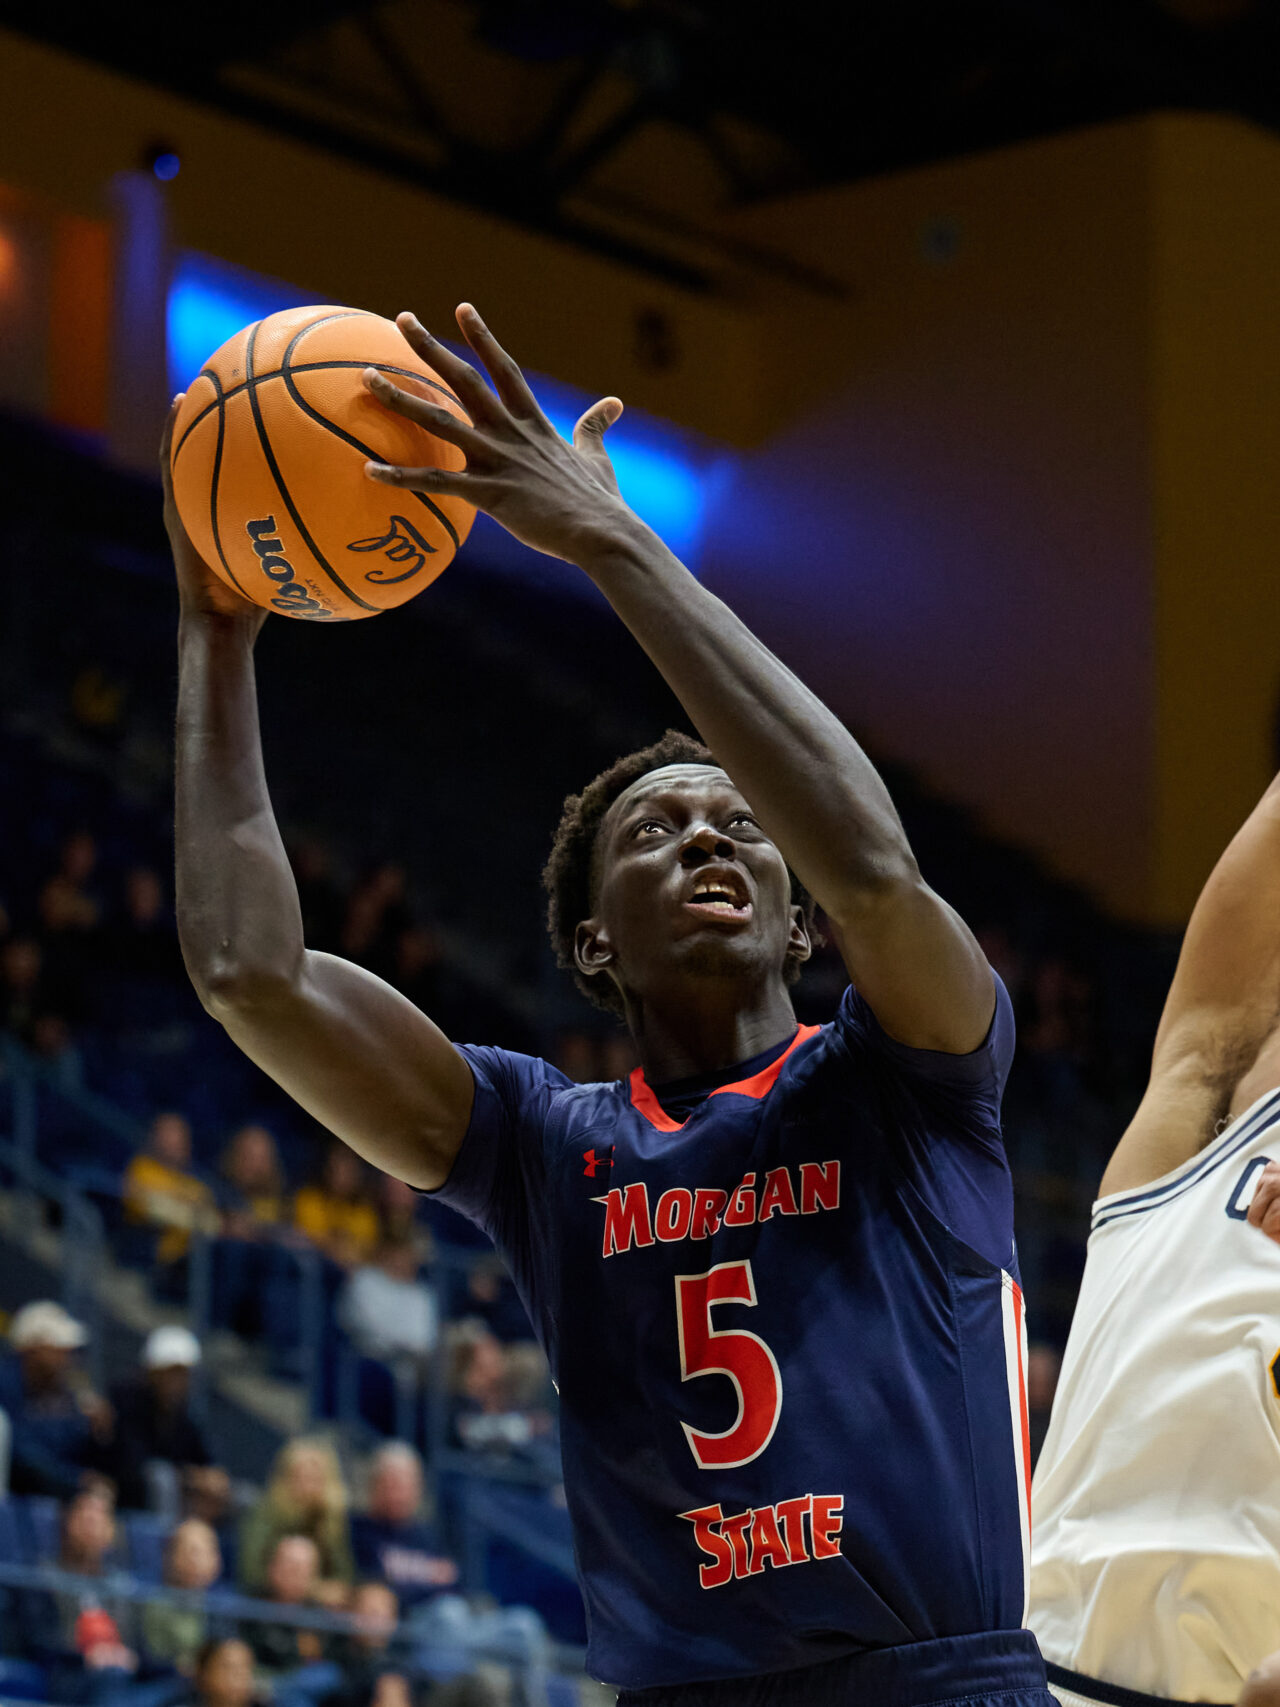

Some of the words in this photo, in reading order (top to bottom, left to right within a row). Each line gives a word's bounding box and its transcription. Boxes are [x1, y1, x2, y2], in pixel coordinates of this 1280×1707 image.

[246, 515, 342, 621] ilson
[346, 515, 438, 584] Cal
[590, 1160, 840, 1258] MORGAN
[674, 1259, 783, 1470] 5
[676, 1493, 843, 1589] STATE
